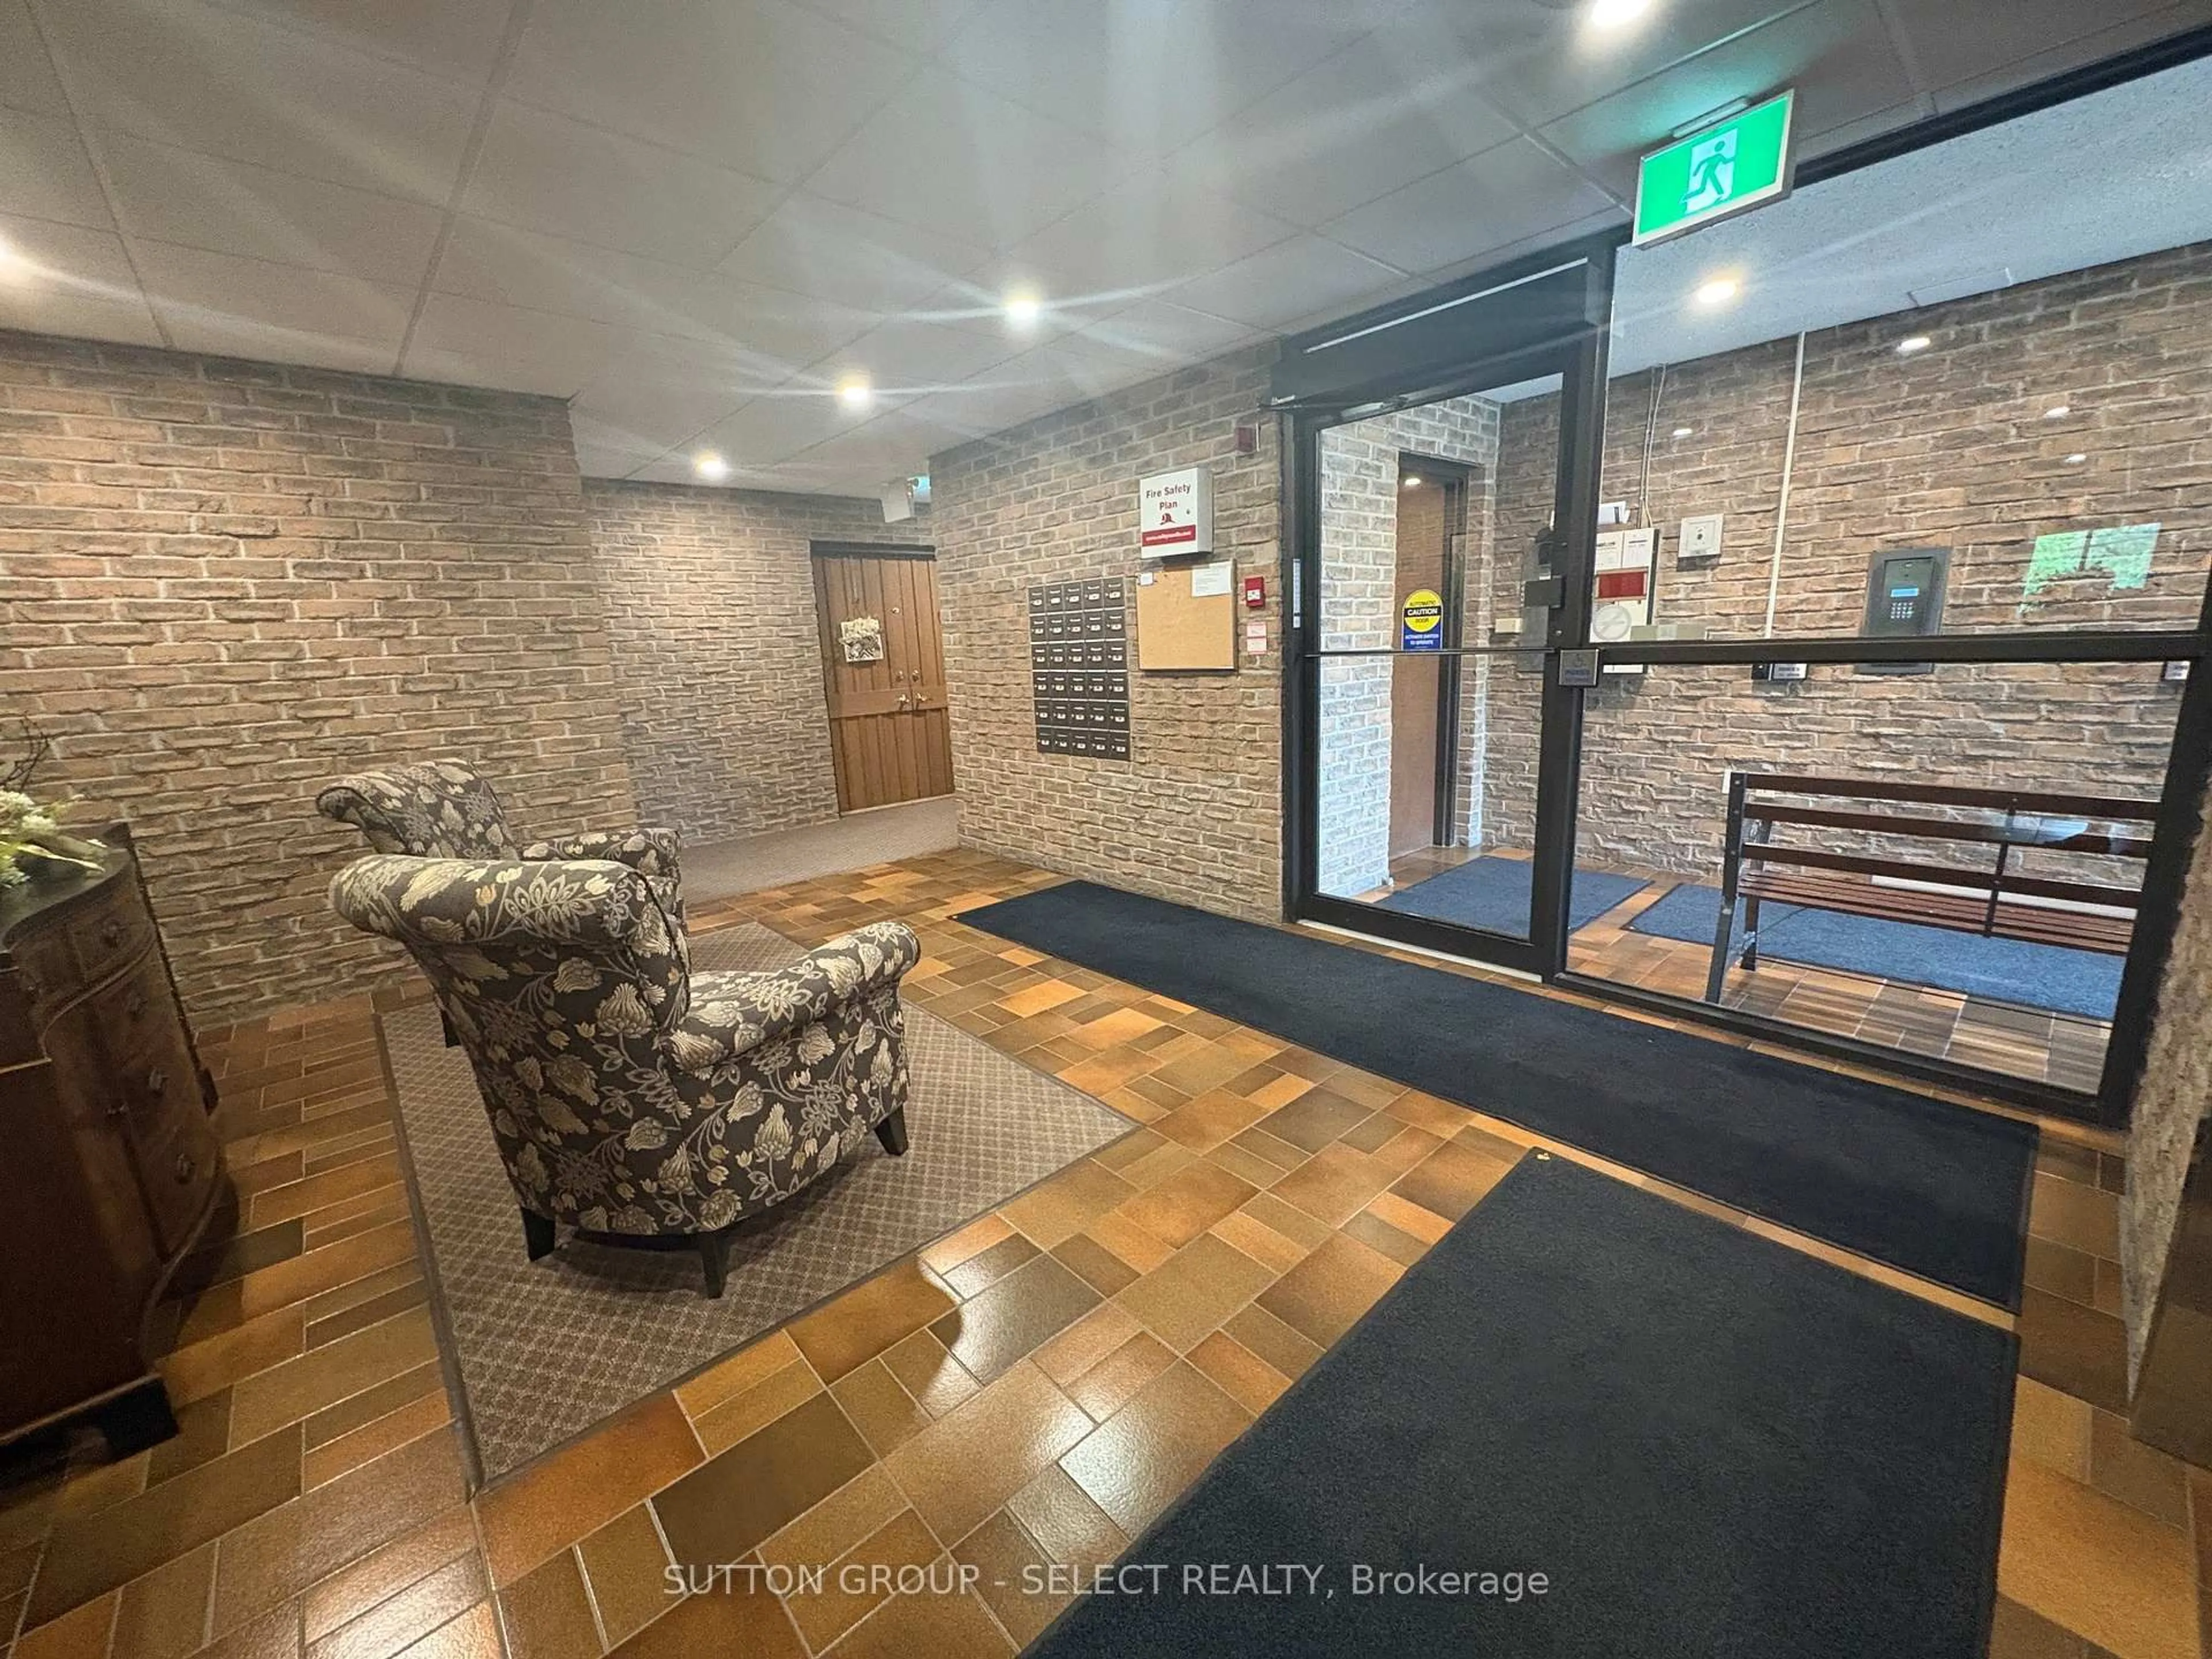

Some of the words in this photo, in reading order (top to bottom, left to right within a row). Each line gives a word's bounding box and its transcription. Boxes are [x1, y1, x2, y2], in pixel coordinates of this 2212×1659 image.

[1146, 490, 1162, 498] Fire
[1164, 483, 1191, 495] Safety
[1160, 501, 1177, 510] Plan
[1407, 608, 1438, 616] CAUTION
